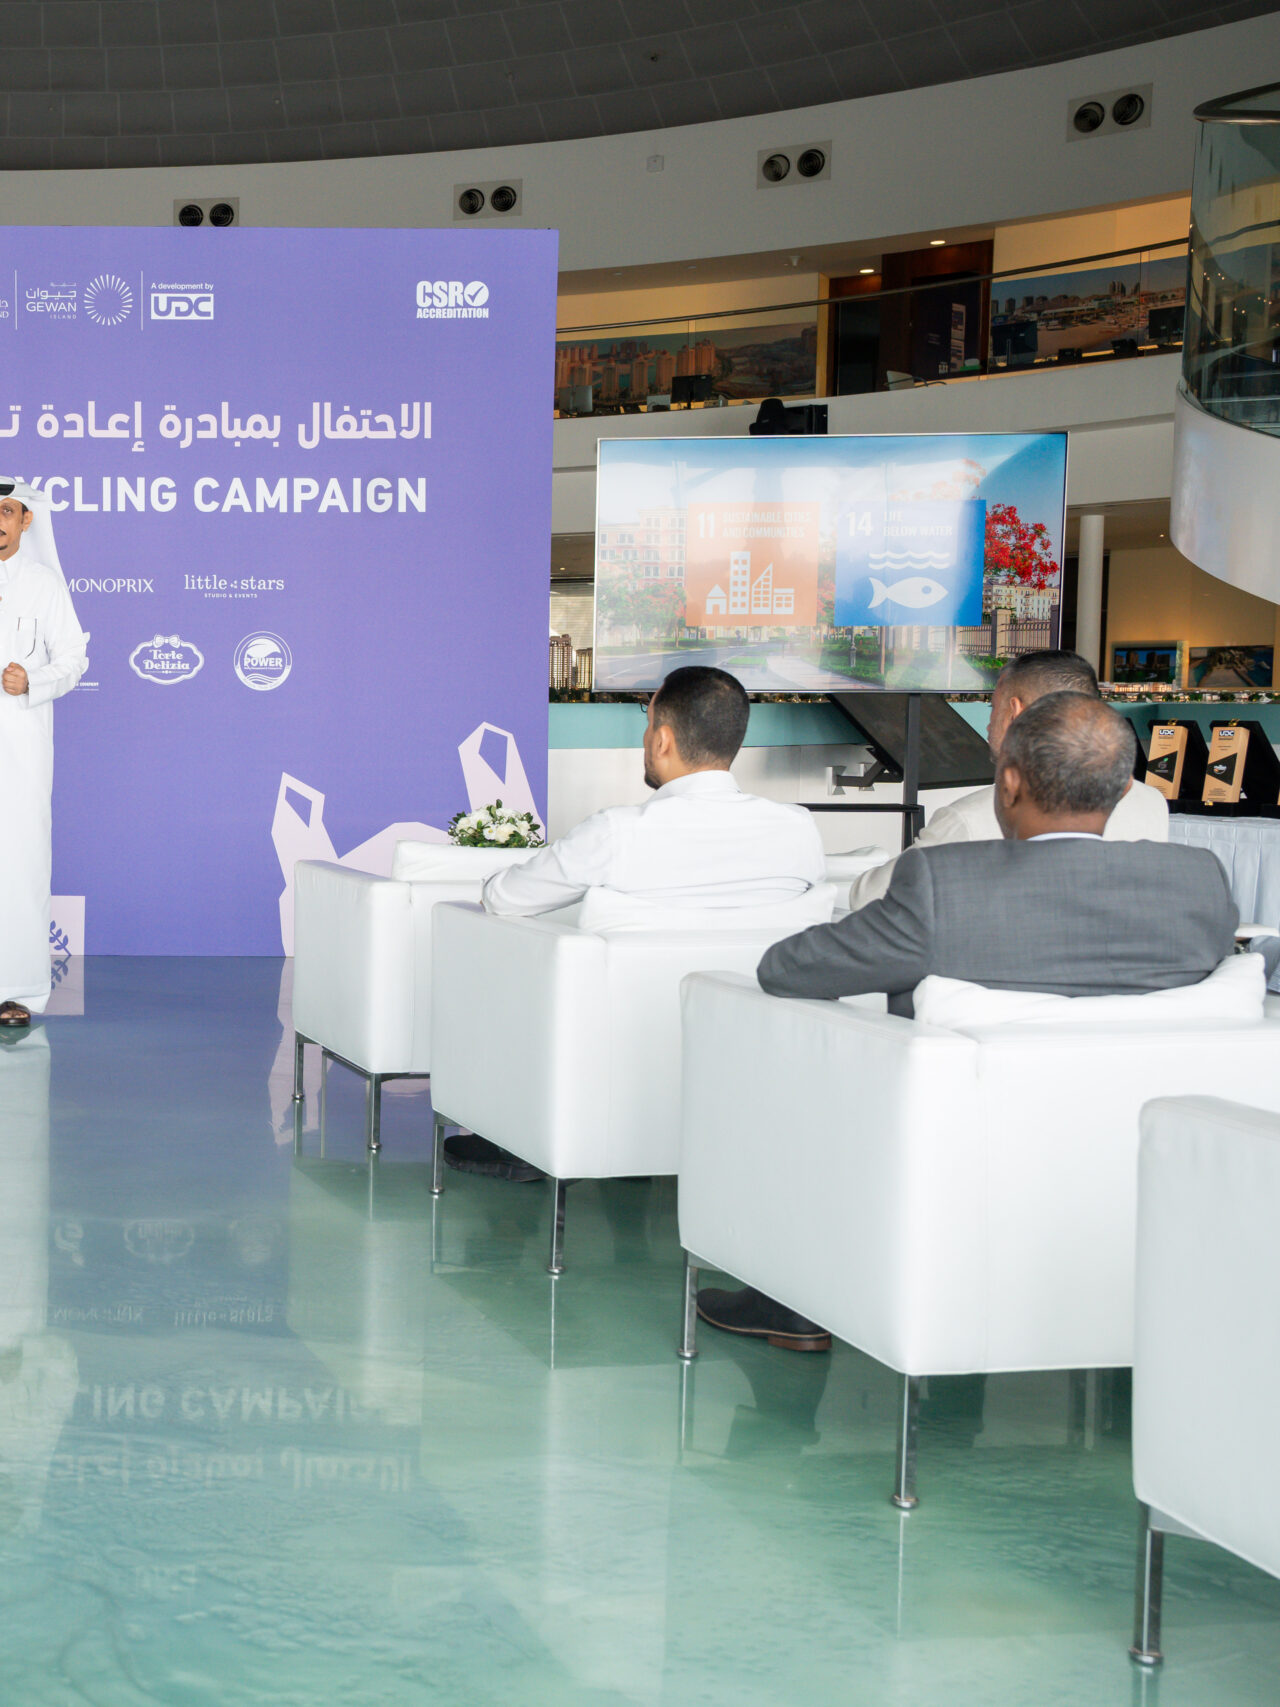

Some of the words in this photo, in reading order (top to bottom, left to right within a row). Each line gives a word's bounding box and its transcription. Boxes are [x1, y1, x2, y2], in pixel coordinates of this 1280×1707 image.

[158, 282, 203, 291] development
[204, 282, 214, 291] by
[25, 287, 77, 300] جيوان
[416, 280, 464, 307] CSR
[25, 301, 77, 312] GEWAN
[153, 295, 212, 318] UDC
[416, 308, 489, 318] ACCREDITATION
[37, 401, 145, 452] إعادة
[159, 402, 281, 448] بمبادرة
[298, 401, 431, 449] الاحتفال
[193, 477, 427, 513] CAMPAIGN
[722, 511, 782, 522] SUSTAINABLE
[882, 511, 903, 522] LIFE
[697, 512, 716, 538] 11
[846, 511, 873, 536] 14
[743, 527, 805, 537] COMMUNITIES
[883, 526, 918, 536] BELOW
[919, 526, 952, 536] WATER
[184, 574, 227, 590] little
[240, 576, 285, 590] stars
[149, 649, 183, 660] Torte
[143, 659, 190, 670] Delizia
[244, 657, 283, 667] POWER
